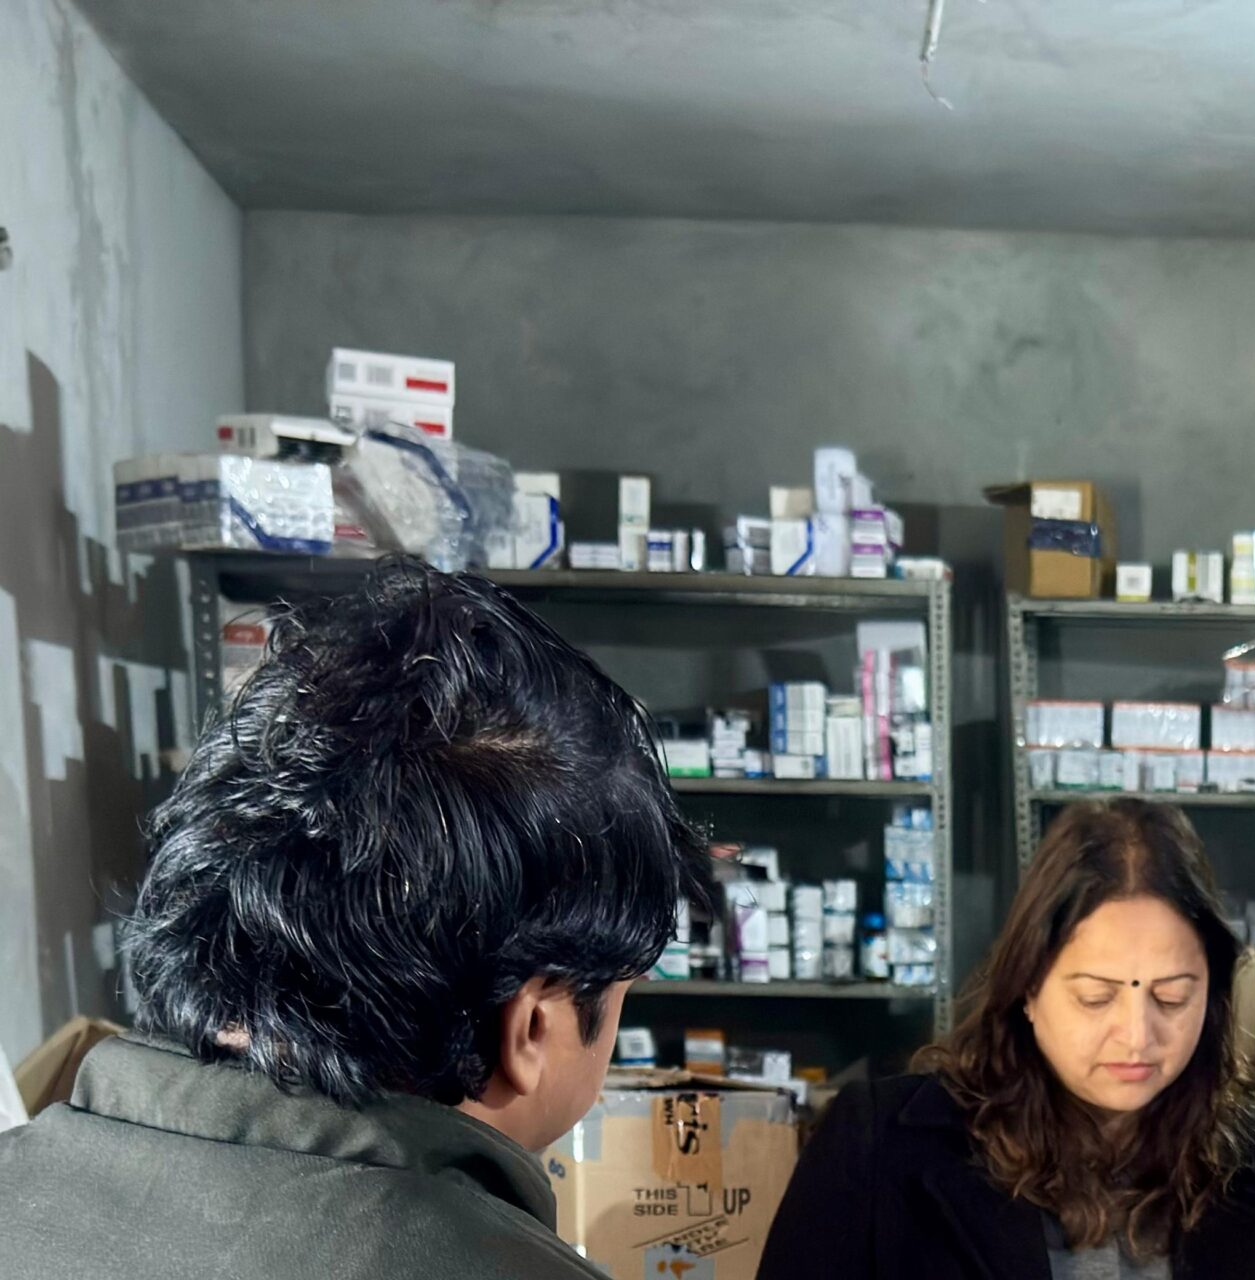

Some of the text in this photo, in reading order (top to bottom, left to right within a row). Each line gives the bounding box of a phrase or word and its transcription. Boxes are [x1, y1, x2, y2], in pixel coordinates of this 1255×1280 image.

[633, 1188, 678, 1200] THIS
[723, 1187, 751, 1216] UP
[634, 1203, 679, 1217] SIDE
